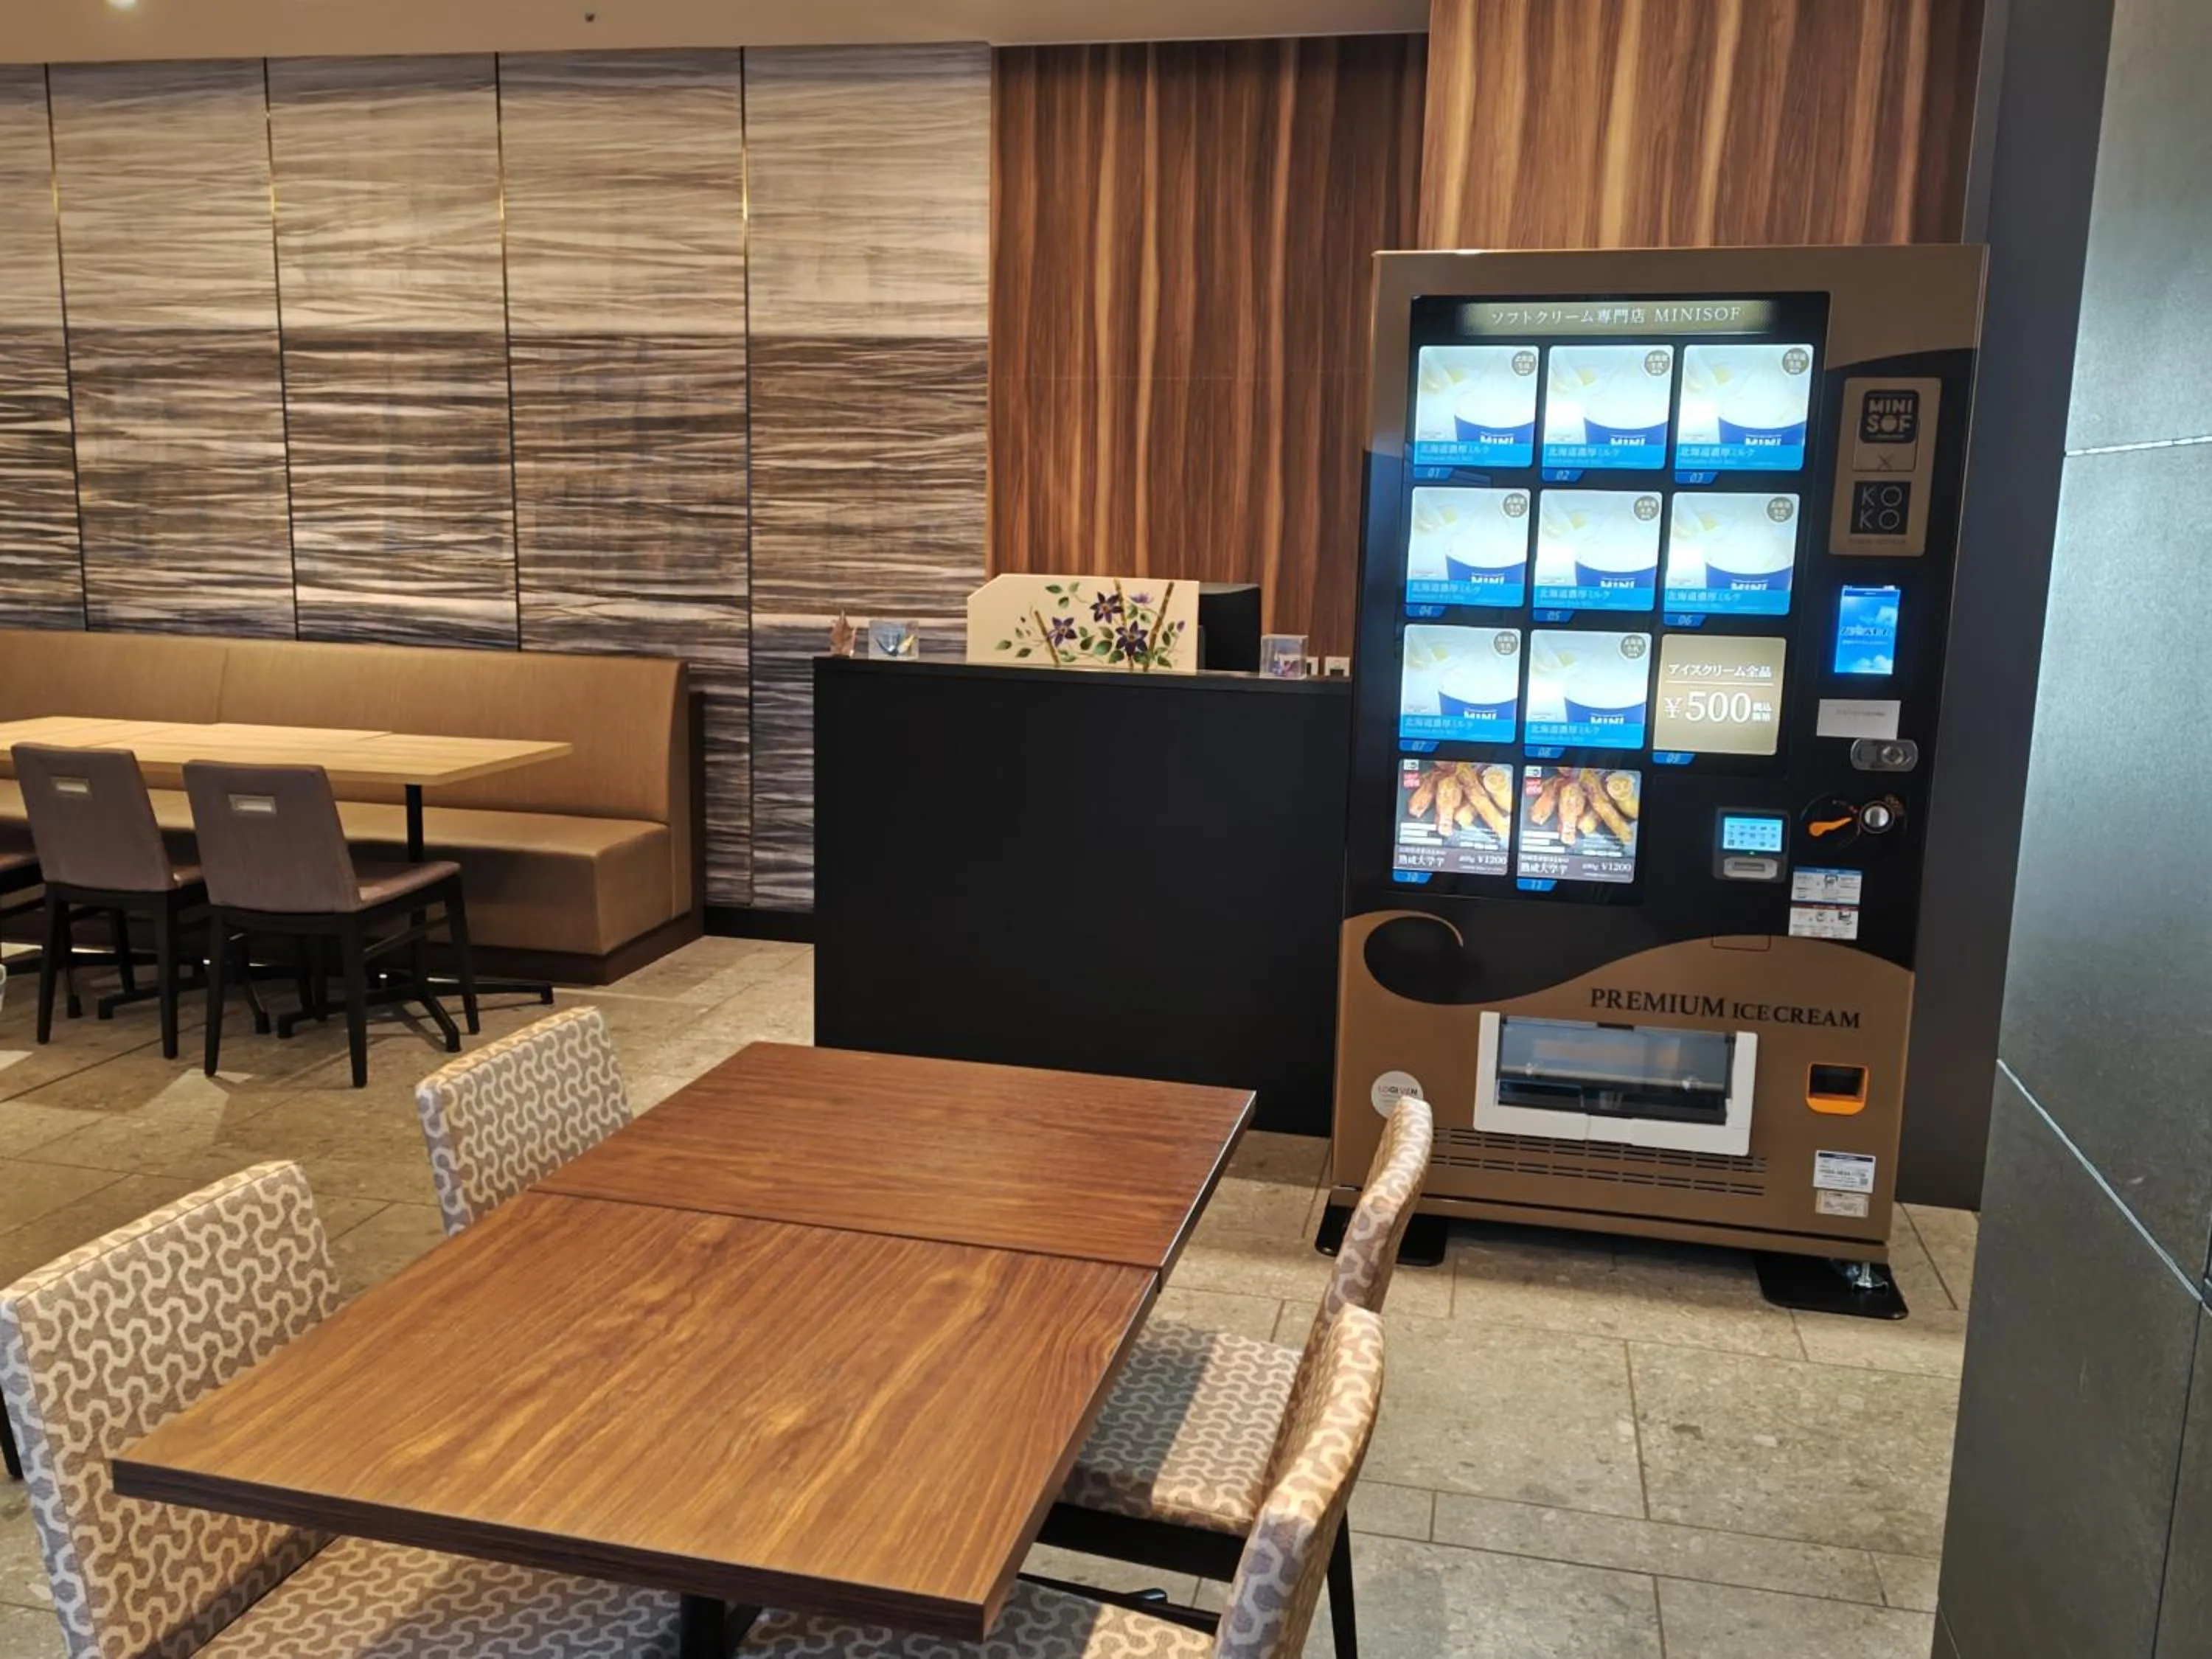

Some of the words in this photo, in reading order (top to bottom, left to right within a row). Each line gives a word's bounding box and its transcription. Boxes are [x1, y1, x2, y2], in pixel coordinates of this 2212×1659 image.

[1491, 307, 1646, 324] ソフトクリーム専門店
[1654, 306, 1742, 321] MINISOF
[1868, 399, 1913, 414] MINI
[1866, 415, 1913, 433] SOF
[1427, 467, 1441, 479] 01
[1556, 470, 1570, 480] 02
[1861, 486, 1902, 507] KO
[1860, 509, 1900, 530] KO
[1547, 611, 1562, 622] 05
[1677, 615, 1694, 625] 06
[1669, 664, 1772, 678] アイスクリーム全品
[1663, 691, 1752, 723] ¥500
[1411, 741, 1426, 751] 07
[1666, 753, 1681, 763] 09
[1590, 987, 1725, 1018] PREMIUM
[1733, 1001, 1770, 1020] ICE
[1773, 1005, 1860, 1029] CREAM
